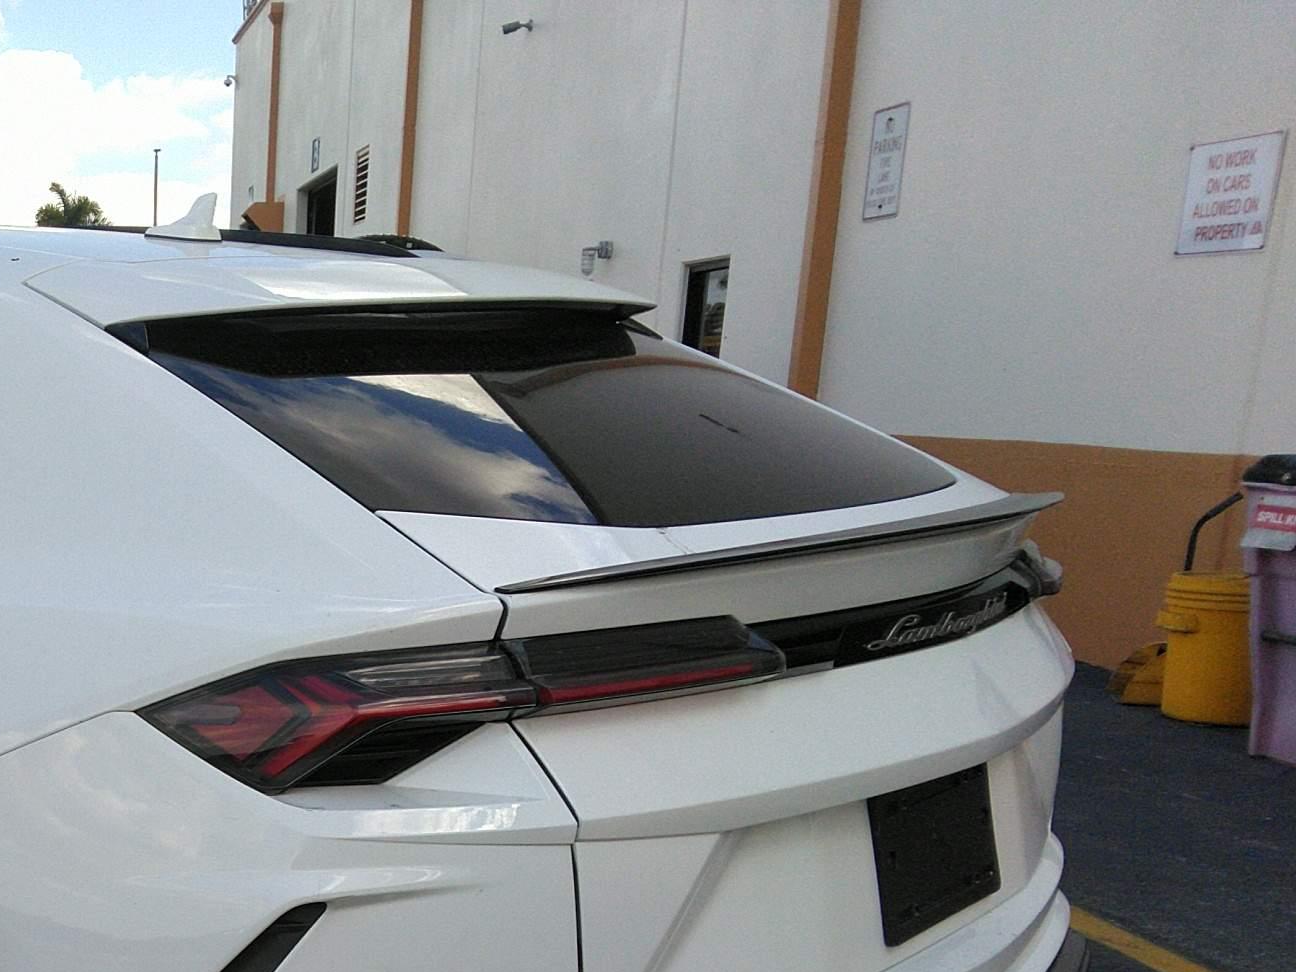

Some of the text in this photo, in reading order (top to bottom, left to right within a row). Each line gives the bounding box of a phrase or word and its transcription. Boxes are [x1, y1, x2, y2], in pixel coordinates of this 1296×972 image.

[1207, 148, 1258, 170] NO WORK
[1206, 174, 1253, 194] ON CARS
[1192, 197, 1260, 218] ALLOWED ON
[1194, 222, 1247, 241] PROPERTY
[1257, 511, 1284, 524] SPILL
